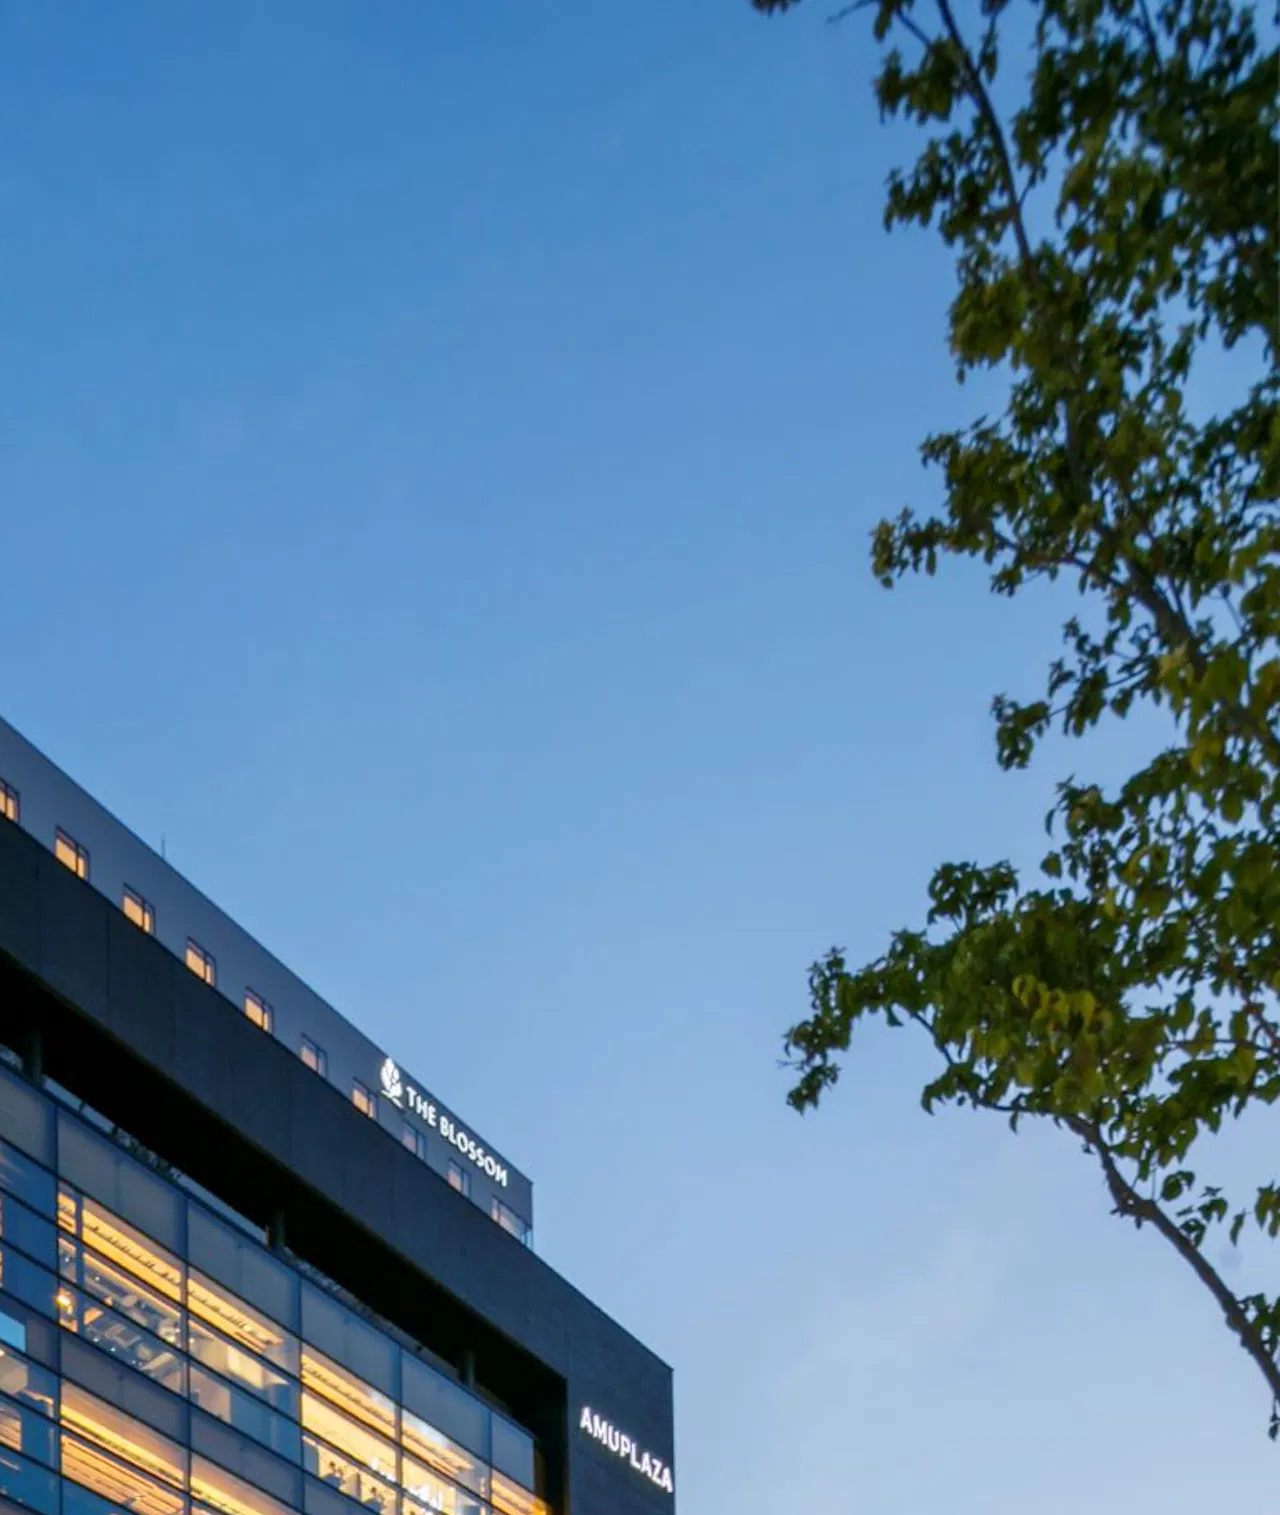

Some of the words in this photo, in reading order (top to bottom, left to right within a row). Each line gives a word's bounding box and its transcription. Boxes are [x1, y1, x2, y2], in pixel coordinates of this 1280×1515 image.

[406, 1085, 437, 1127] THE
[439, 1115, 508, 1188] BLOSSOM
[579, 1406, 674, 1494] AMUPLAZA
